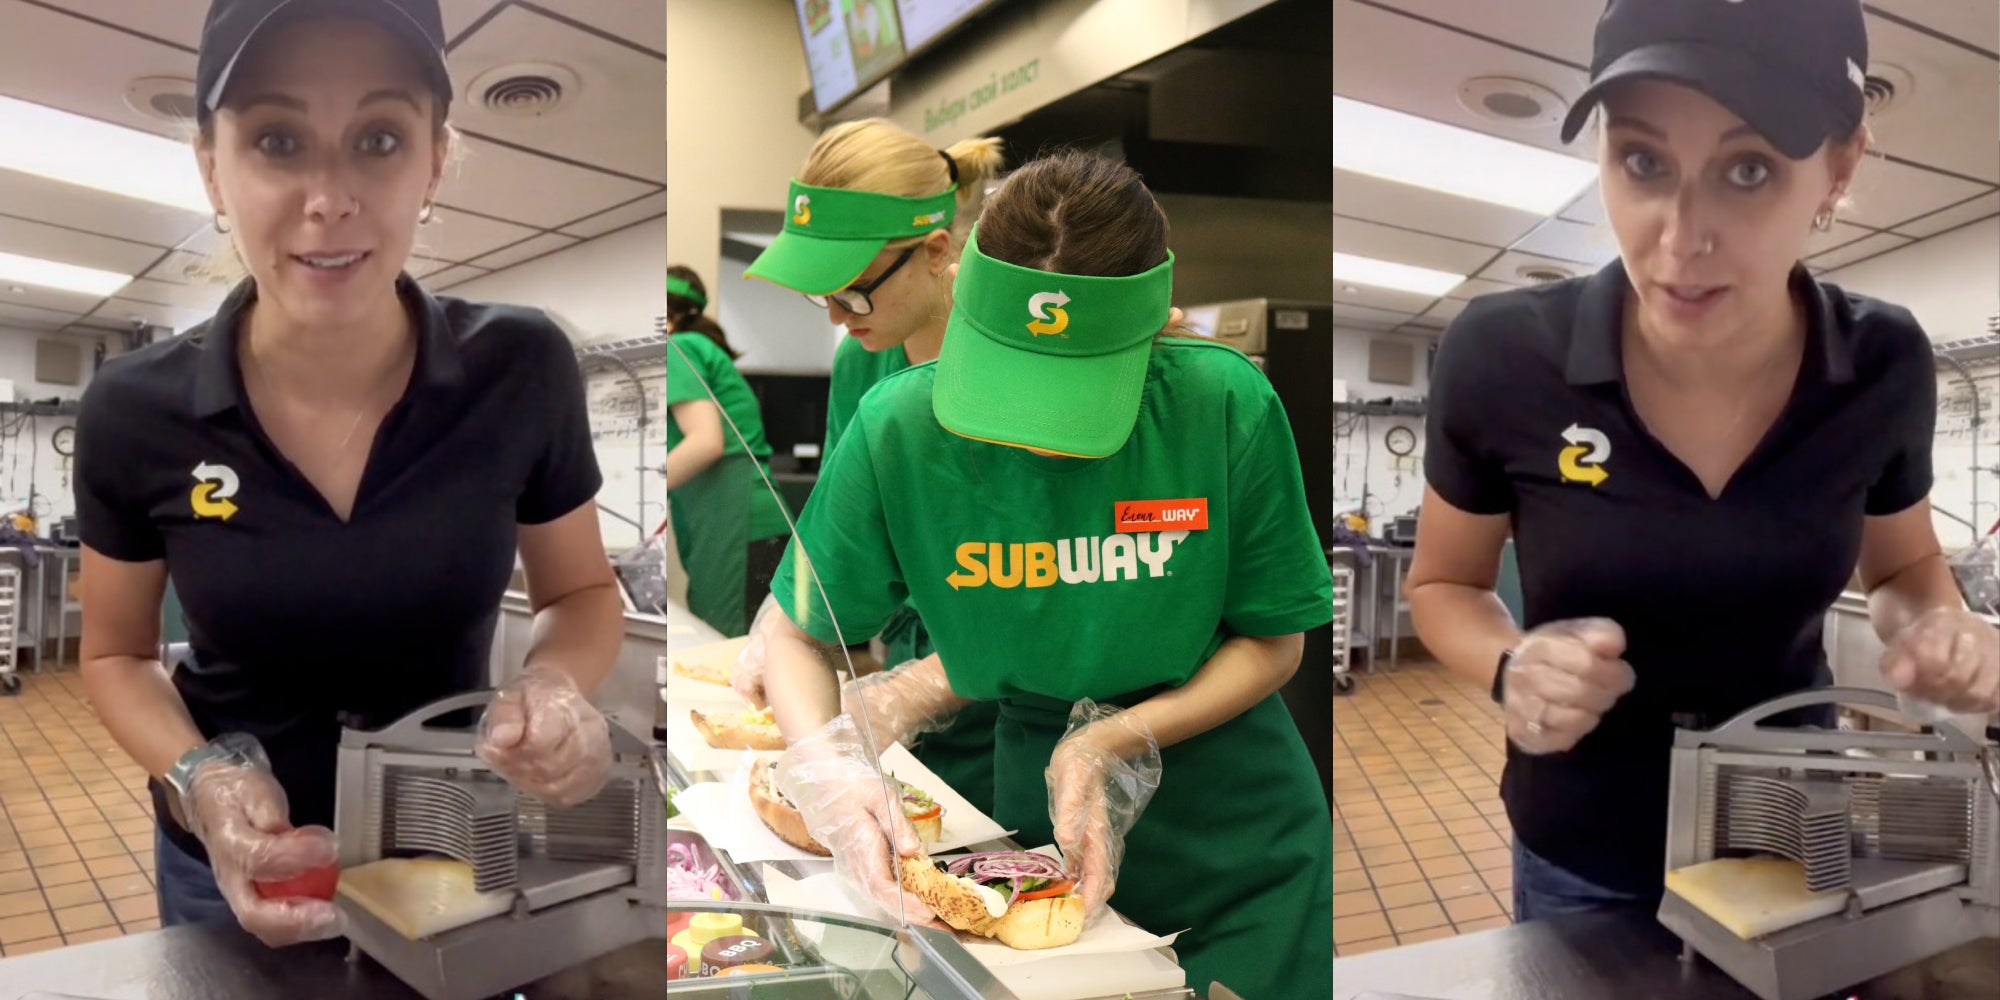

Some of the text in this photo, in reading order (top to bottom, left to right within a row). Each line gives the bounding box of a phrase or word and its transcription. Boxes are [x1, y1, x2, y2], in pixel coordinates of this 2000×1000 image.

[1162, 508, 1200, 522] WAY
[946, 531, 1190, 591] SUBWAY
[718, 940, 762, 957] BBQ
